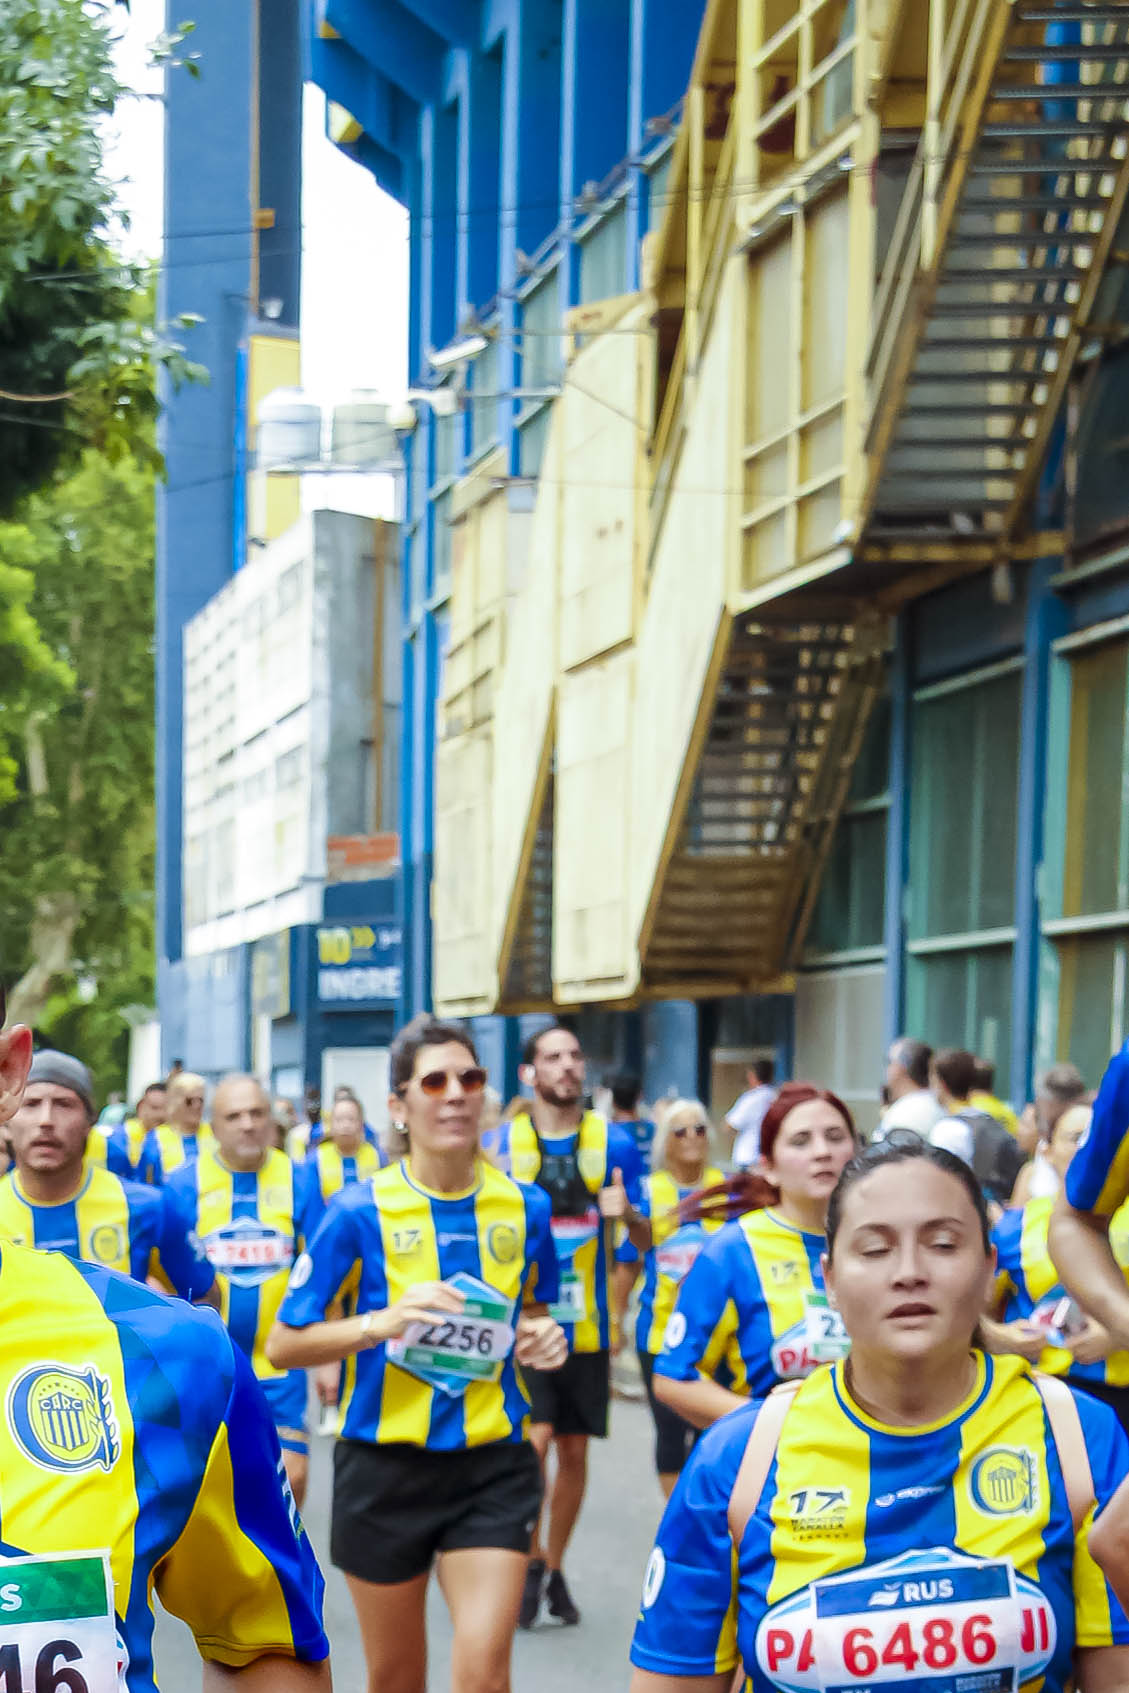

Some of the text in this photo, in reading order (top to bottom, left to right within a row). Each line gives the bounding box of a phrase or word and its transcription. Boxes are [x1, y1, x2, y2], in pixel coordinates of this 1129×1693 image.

[418, 1321, 494, 1355] 2256
[790, 1490, 846, 1514] 17
[902, 1578, 954, 1603] RUS
[842, 1614, 998, 1677] 6486
